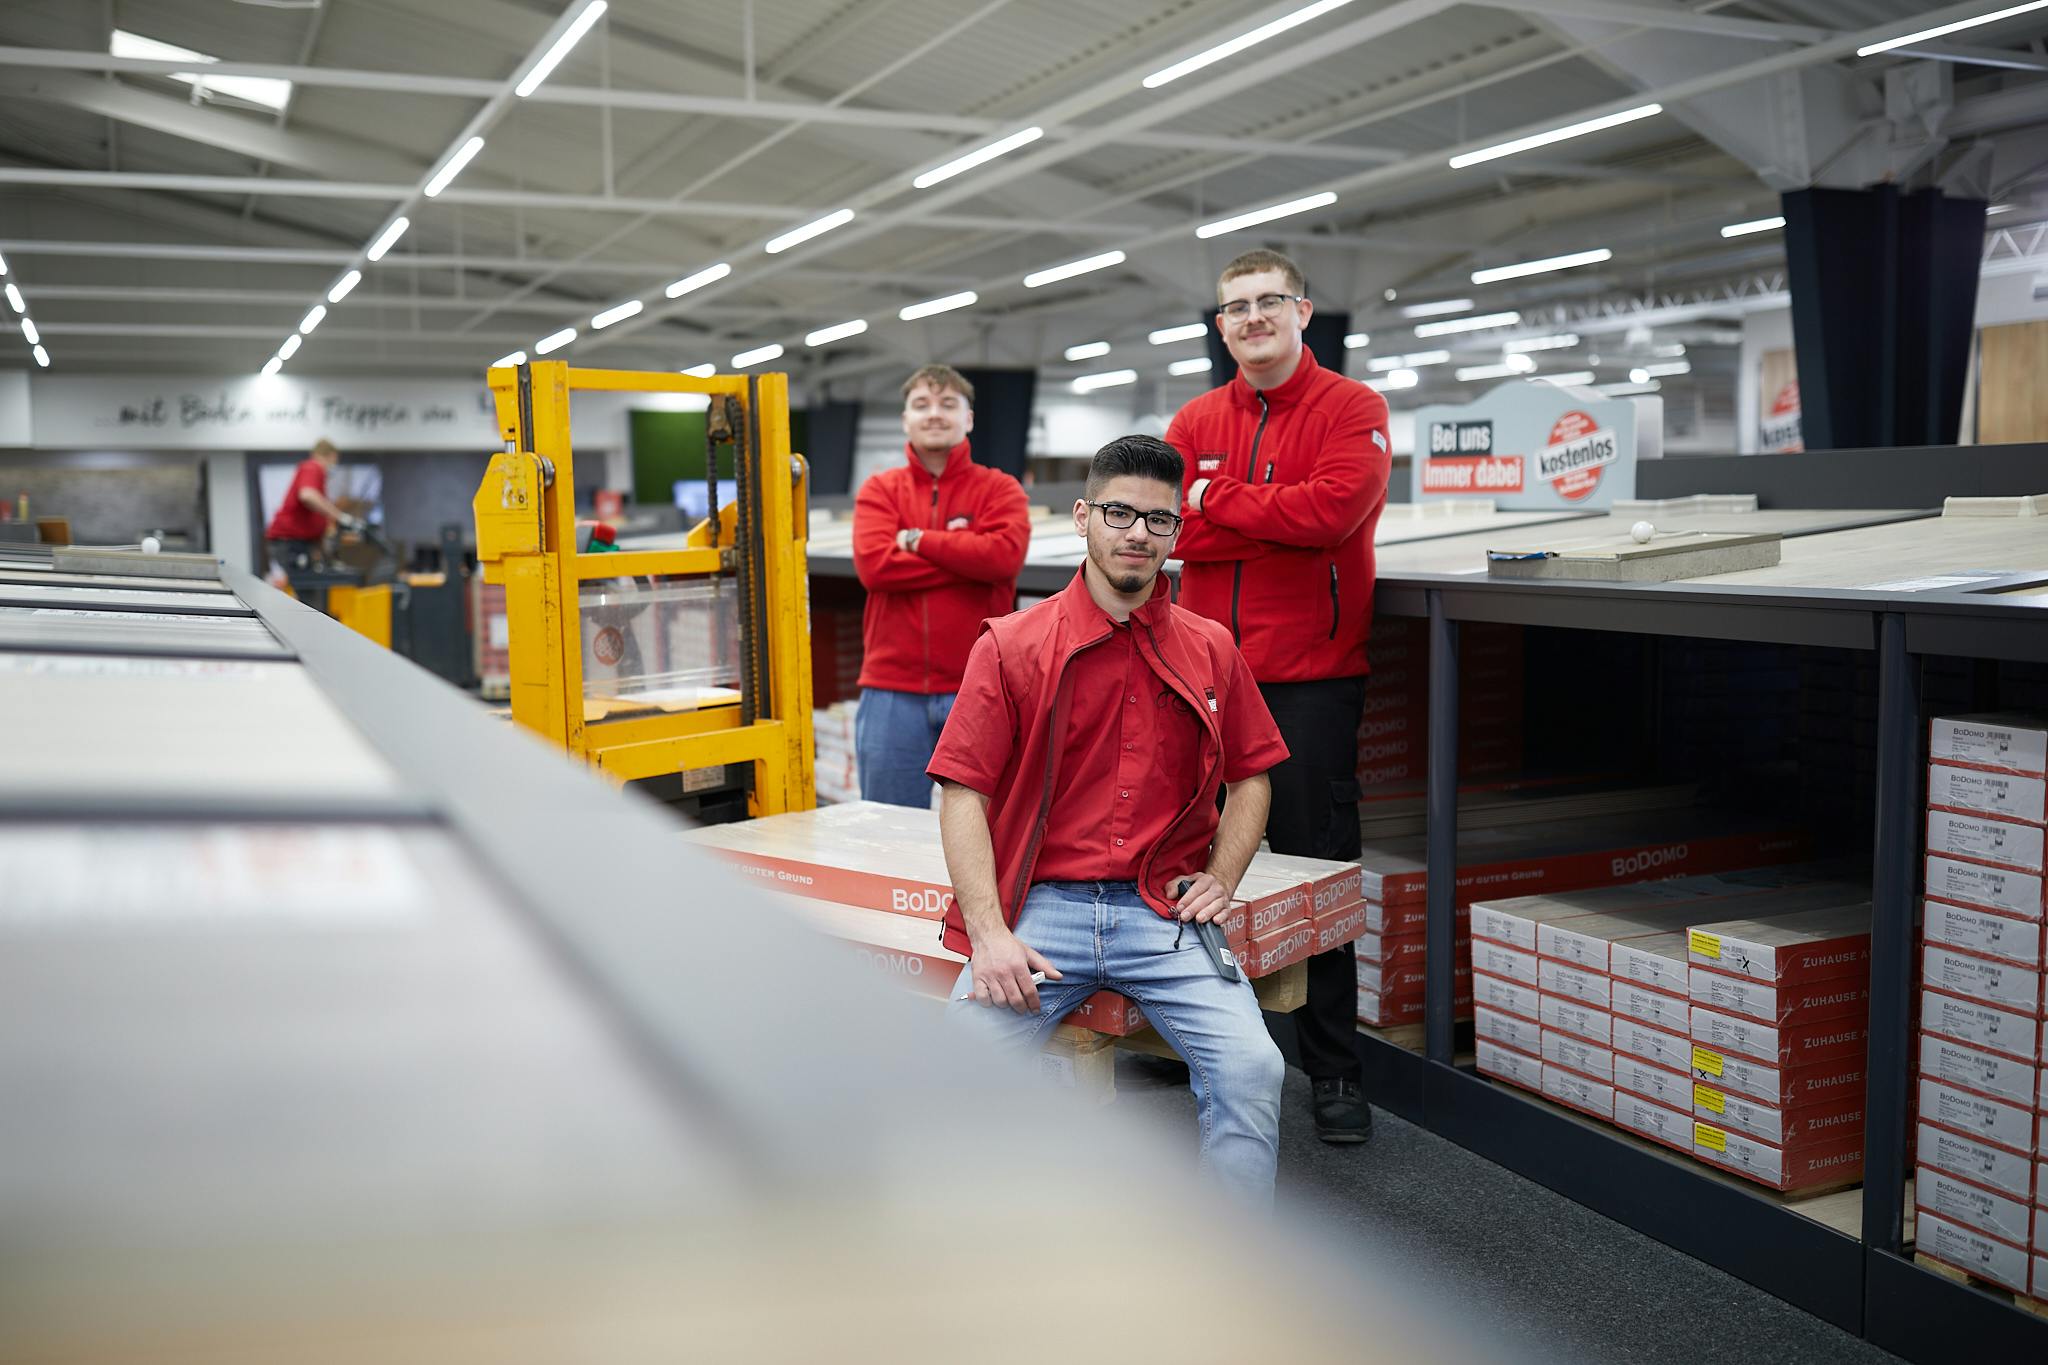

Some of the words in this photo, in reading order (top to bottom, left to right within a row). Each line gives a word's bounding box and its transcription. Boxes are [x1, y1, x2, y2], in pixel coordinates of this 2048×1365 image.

[1431, 423, 1457, 453] Bei
[1460, 425, 1490, 450] uns
[1540, 436, 1613, 475] kostenlos
[1424, 461, 1473, 487] Immer
[1475, 457, 1521, 486] dabei
[777, 870, 814, 885] GRUND
[1511, 869, 1545, 881] GRUND
[892, 888, 954, 914] BODO
[1803, 951, 1857, 968] ZUHAUSE
[1803, 991, 1857, 1009] ZUHAUSE
[1804, 1031, 1858, 1049] ZUHAUSE
[1807, 1072, 1860, 1090] ZUHAUSE
[1808, 1111, 1861, 1130] ZUHAUSE
[1808, 1152, 1861, 1170] ZUHAUSE
